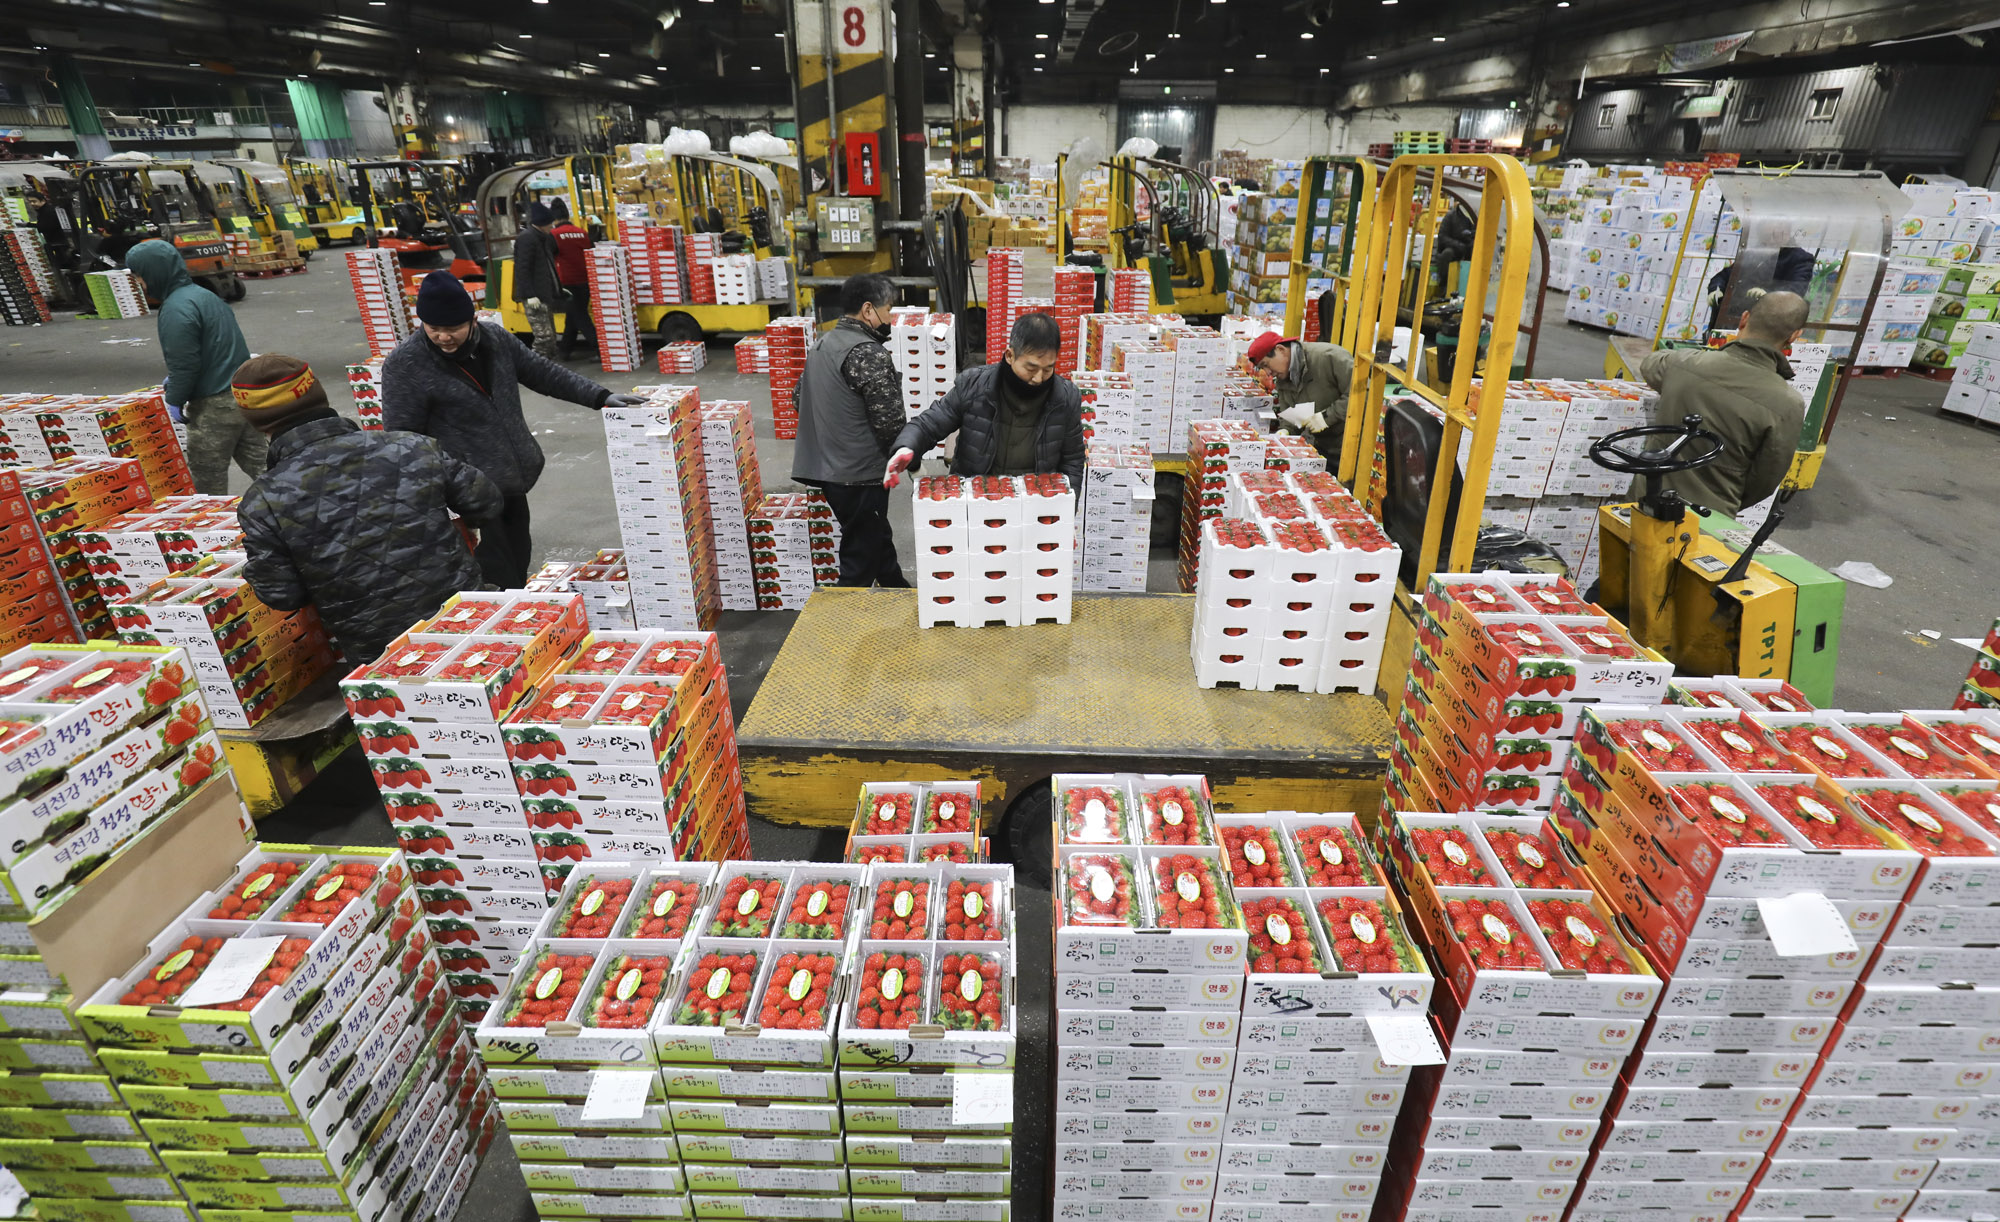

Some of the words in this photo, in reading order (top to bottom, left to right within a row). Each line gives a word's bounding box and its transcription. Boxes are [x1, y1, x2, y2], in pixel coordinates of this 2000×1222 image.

[843, 6, 866, 47] 8
[405, 113, 413, 126] 6
[196, 244, 228, 256] TOYOTA
[94, 472, 120, 486] 딸기
[102, 494, 128, 508] 딸기
[8, 602, 37, 618] 딸기
[178, 610, 203, 622] 딸기
[18, 626, 45, 640] 딸기
[548, 622, 570, 646] 딸기
[188, 636, 213, 648] 딸기
[1470, 626, 1491, 660] 딸기
[199, 661, 223, 672] 딸기
[693, 664, 708, 686] 딸기
[1461, 664, 1482, 698] 딸기
[1590, 669, 1624, 684] 고맛나루
[1627, 670, 1662, 688] 딸기
[208, 685, 231, 695] 딸기
[414, 692, 444, 706] 고맛나루
[446, 692, 482, 710] 딸기
[701, 696, 716, 718] 딸기
[218, 708, 242, 719] 딸기
[1451, 698, 1472, 733] 딸기
[5, 739, 56, 774] 덕천강
[56, 718, 92, 744] 청정
[88, 698, 132, 727] 딸기
[428, 729, 458, 742] 고맛나루
[460, 730, 496, 746] 딸기
[576, 735, 606, 748] 고맛나루
[610, 736, 646, 752] 딸기
[706, 728, 722, 752] 딸기
[1442, 732, 1462, 768] 딸기
[440, 764, 469, 778] 고맛나루
[472, 766, 506, 781] 딸기
[711, 759, 726, 783] 딸기
[32, 783, 81, 819] 덕천강
[80, 760, 114, 787] 청정
[110, 740, 152, 769] 딸기
[586, 772, 616, 785] 고맛나루
[619, 773, 654, 788] 딸기
[1435, 766, 1453, 800] 딸기
[452, 798, 480, 812] 고맛나루
[482, 800, 516, 815] 딸기
[592, 806, 622, 819] 고맛나루
[624, 808, 658, 822] 딸기
[54, 827, 100, 864] 덕천강
[100, 804, 132, 831] 청정
[129, 782, 168, 812] 딸기
[1648, 792, 1681, 840] 딸기
[464, 832, 491, 844] 고맛나루
[492, 833, 526, 848] 딸기
[602, 840, 630, 852] 고맛나루
[632, 842, 666, 856] 딸기
[1633, 834, 1664, 880] 딸기
[472, 864, 500, 876] 고맛나루
[502, 866, 535, 880] 딸기
[1879, 867, 1903, 878] 명품
[482, 896, 508, 907] 고맛나루
[510, 896, 542, 910] 딸기
[1619, 872, 1649, 919] 딸기
[1856, 911, 1880, 922] 명품
[1432, 906, 1451, 954] 딸기
[283, 963, 318, 1002] 덕천강
[316, 936, 342, 964] 청정
[338, 908, 368, 938] 딸기
[1066, 950, 1095, 962] 딸기
[1212, 944, 1234, 955] 명품
[300, 999, 334, 1038] 덕천강
[332, 971, 356, 1000] 청정
[353, 942, 382, 973] 딸기
[1066, 989, 1093, 1000] 딸기
[1208, 984, 1229, 994] 명품
[1624, 991, 1646, 1001] 명품
[1814, 990, 1835, 1000] 명품
[318, 1034, 350, 1074] 덕천강
[347, 1005, 370, 1034] 청정
[366, 976, 394, 1008] 딸기
[1066, 1026, 1094, 1038] 딸기
[1206, 1020, 1226, 1030] 명품
[1606, 1028, 1626, 1038] 명품
[1248, 1032, 1276, 1044] 딸기
[336, 1062, 366, 1102] 덕천강
[363, 1034, 385, 1062] 청정
[382, 1004, 408, 1036] 딸기
[610, 1040, 644, 1062] 10
[1066, 1061, 1093, 1072] 딸기
[1202, 1056, 1222, 1064] 명품
[1589, 1062, 1610, 1071] 명품
[1242, 1066, 1270, 1077] 딸기
[352, 1092, 380, 1132] 덕천강
[377, 1063, 397, 1092] 청정
[394, 1033, 420, 1064] 딸기
[1066, 1094, 1092, 1105] 딸기
[1197, 1088, 1217, 1098] 명품
[1371, 1093, 1390, 1101] 명품
[420, 1090, 442, 1122] 딸기
[1238, 1098, 1264, 1108] 딸기
[1192, 1120, 1213, 1129] 명품
[1362, 1124, 1380, 1132] 명품
[1190, 1149, 1210, 1158] 명품
[1356, 1154, 1374, 1163] 명품
